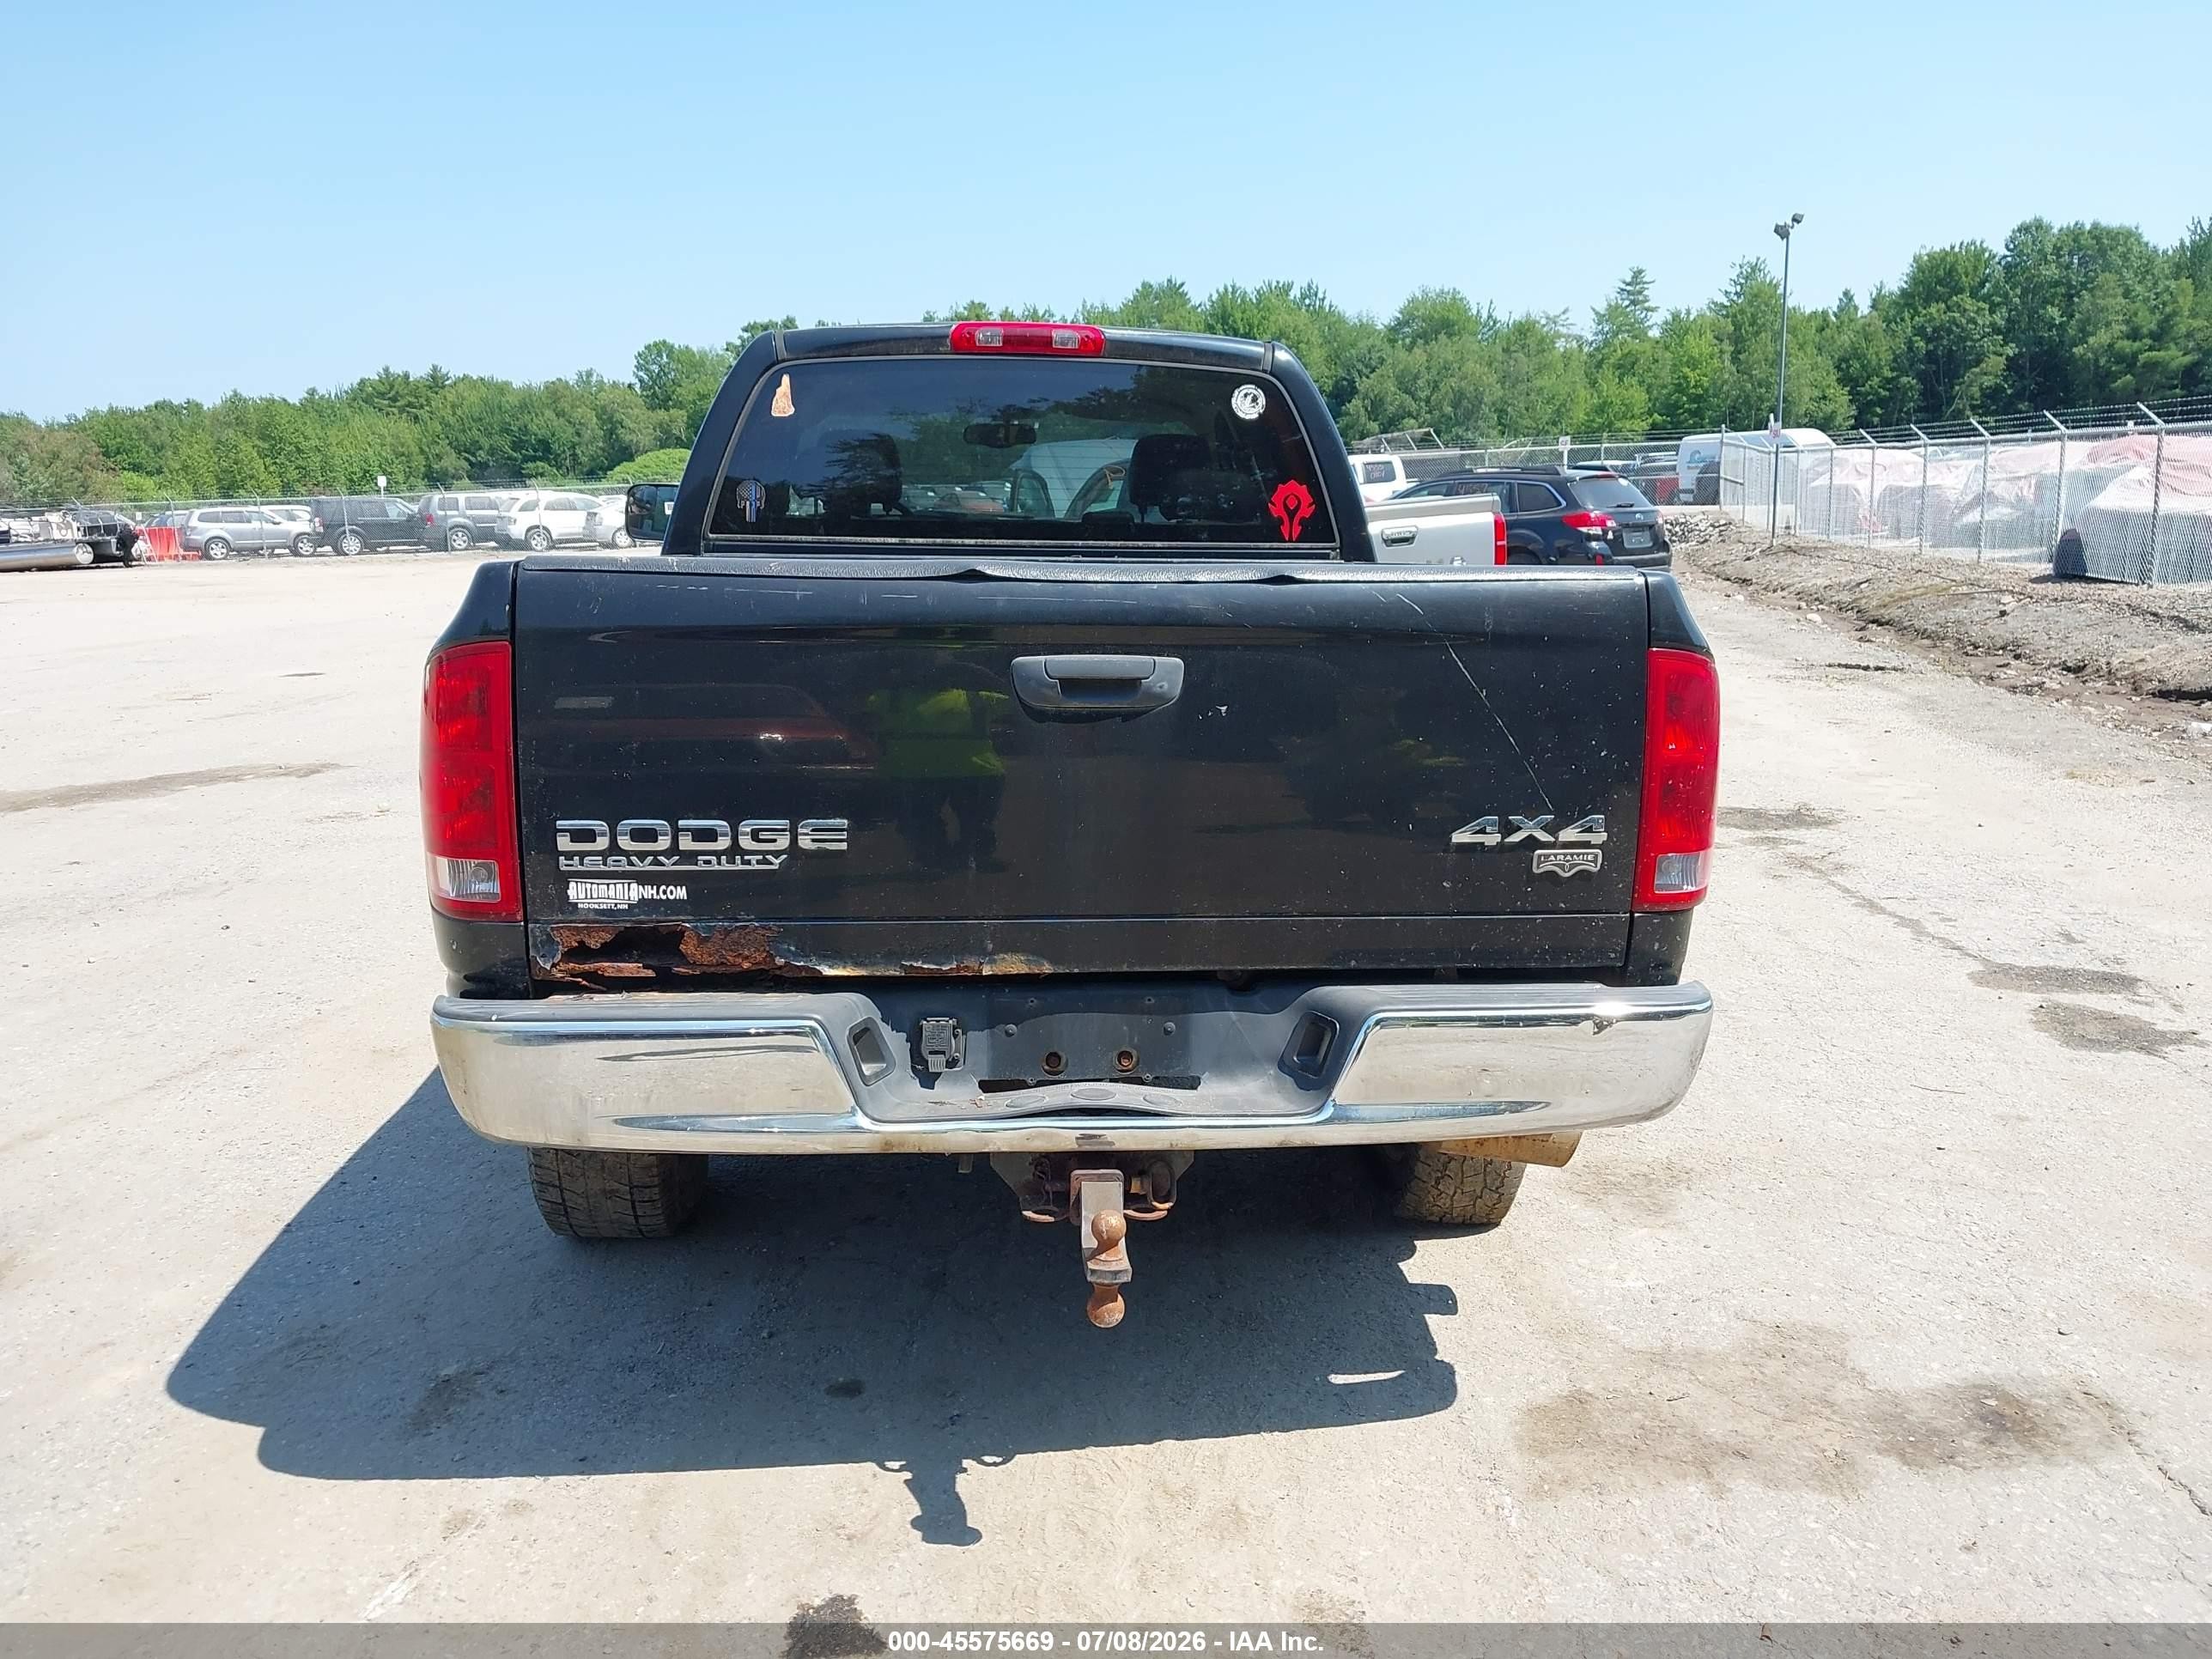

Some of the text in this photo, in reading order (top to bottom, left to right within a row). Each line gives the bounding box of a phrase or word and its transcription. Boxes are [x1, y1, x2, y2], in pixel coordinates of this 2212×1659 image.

[556, 818, 848, 851] DODGE
[1451, 815, 1608, 846] 4X4
[559, 854, 788, 869] HEAVY DUTY
[1540, 854, 1595, 862] LARAMIE
